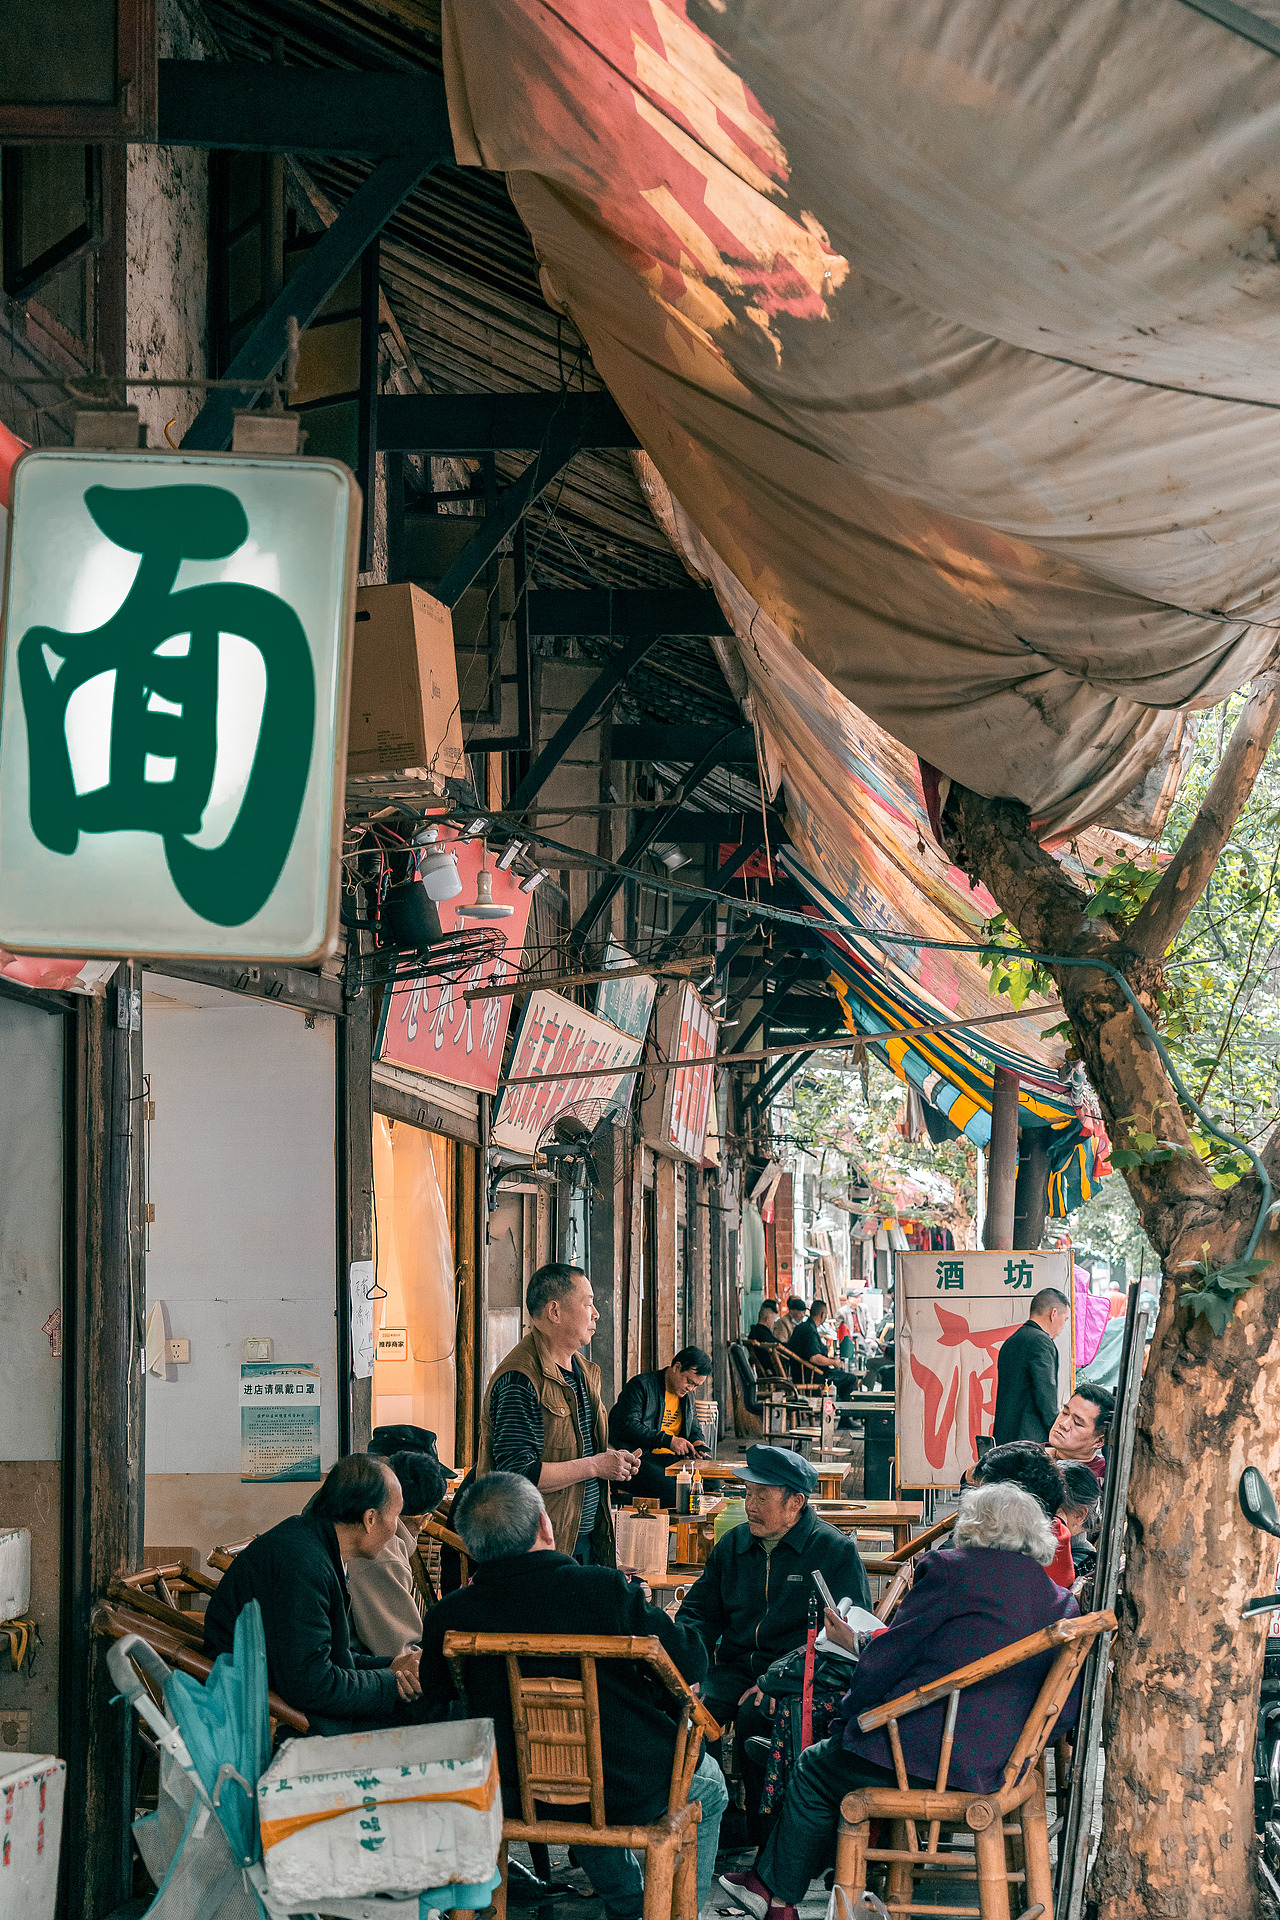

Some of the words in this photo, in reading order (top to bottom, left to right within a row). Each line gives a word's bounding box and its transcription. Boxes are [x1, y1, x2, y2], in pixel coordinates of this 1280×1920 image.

[18, 484, 315, 927] 面
[935, 1260, 1034, 1290] 酒坊
[243, 1384, 315, 1395] 进店请佩戴口罩
